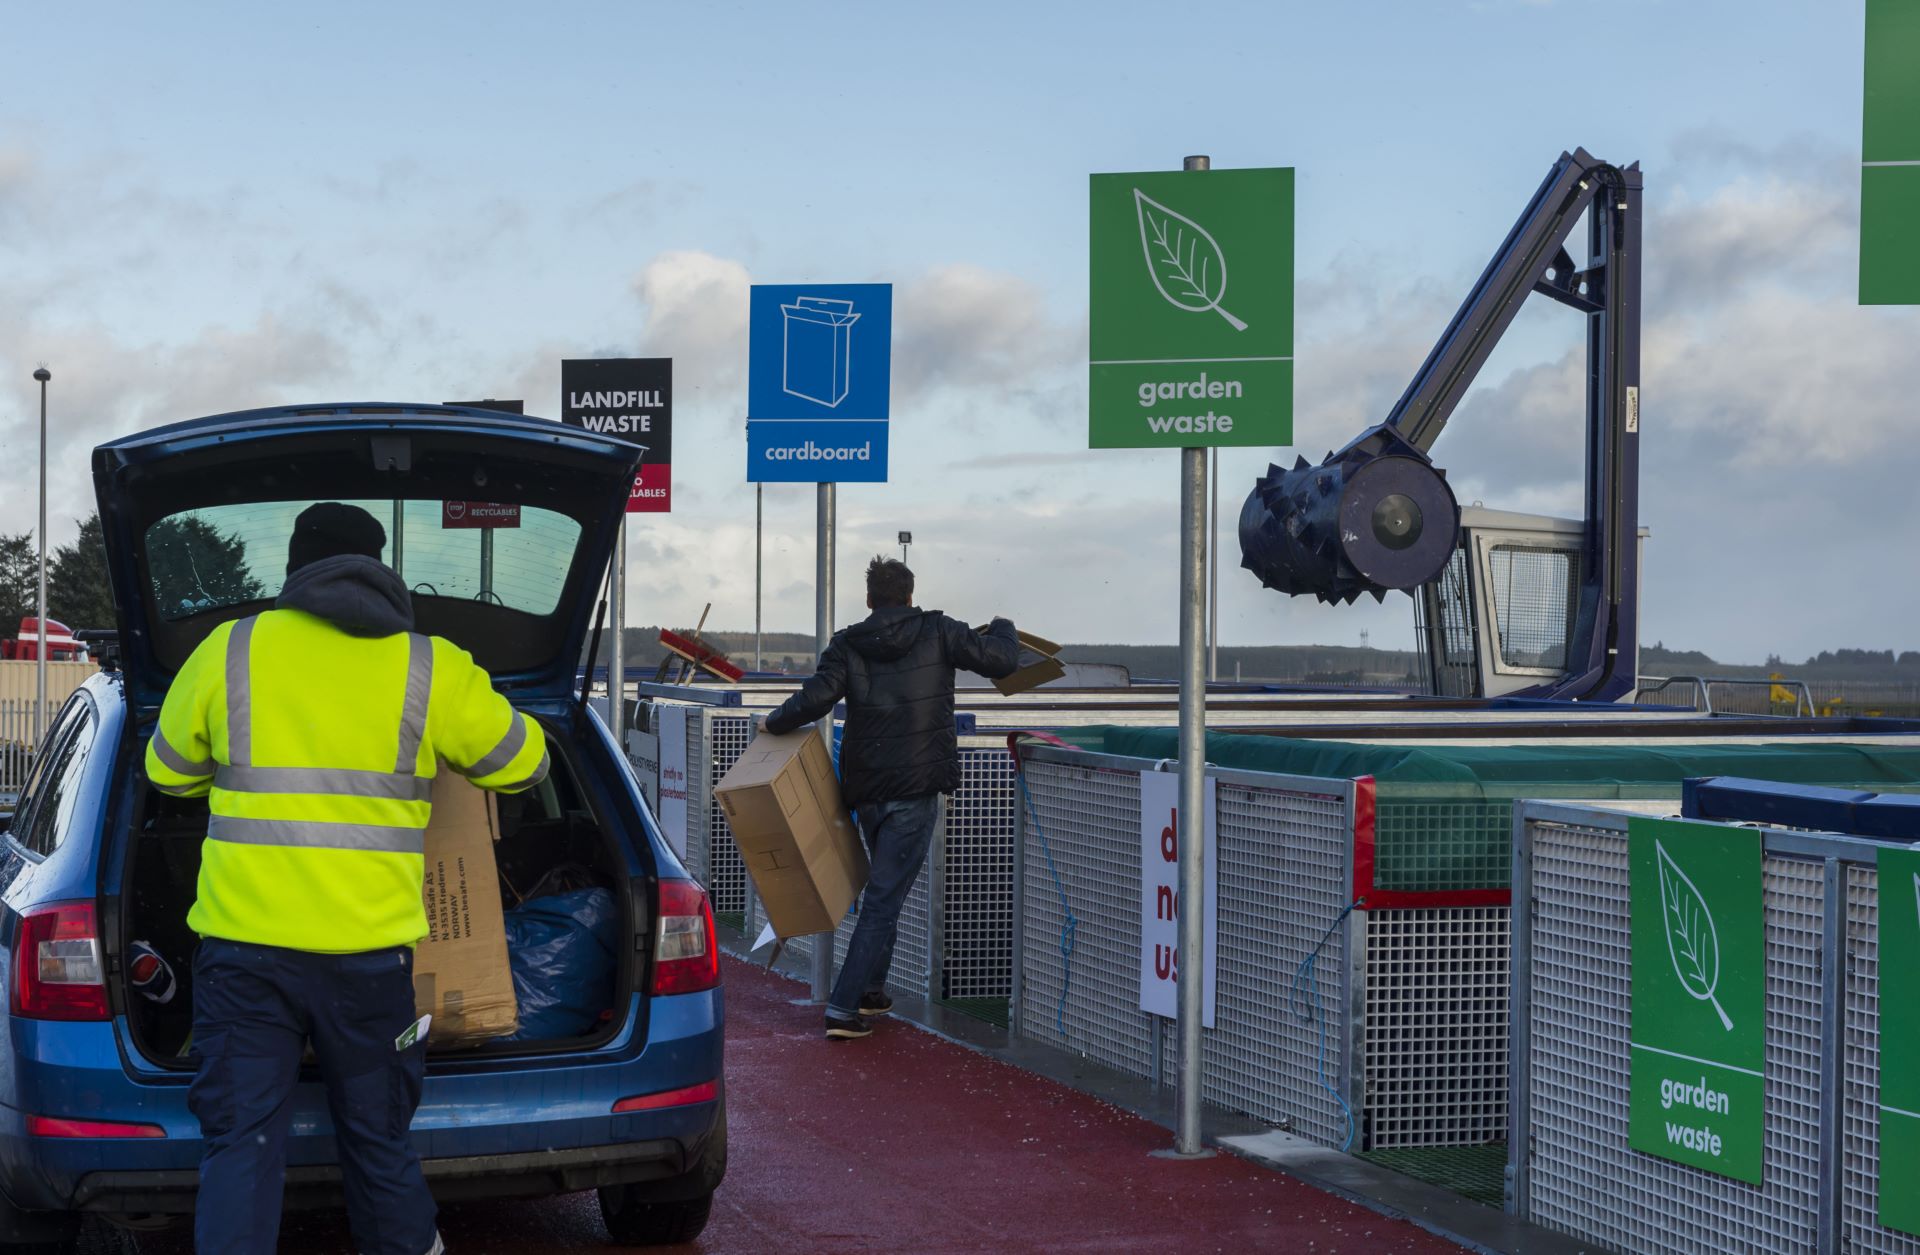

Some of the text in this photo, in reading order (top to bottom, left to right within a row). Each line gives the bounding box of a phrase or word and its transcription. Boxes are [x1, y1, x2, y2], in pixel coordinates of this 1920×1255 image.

[570, 390, 664, 408] LANDFILL
[1138, 372, 1242, 407] garden
[582, 415, 651, 433] WASTE
[1147, 411, 1233, 433] waste
[765, 441, 871, 461] cardboard
[471, 508, 518, 516] RECYCLABLES
[660, 783, 687, 800] plasterboard
[1161, 808, 1178, 863] d
[426, 871, 438, 943] HTS BeSafe AS
[458, 857, 471, 938] www.besafe.com
[440, 906, 449, 941] N-3535
[450, 894, 461, 940] NORWAY
[1661, 1076, 1729, 1115] garden
[1665, 1121, 1722, 1157] waste
